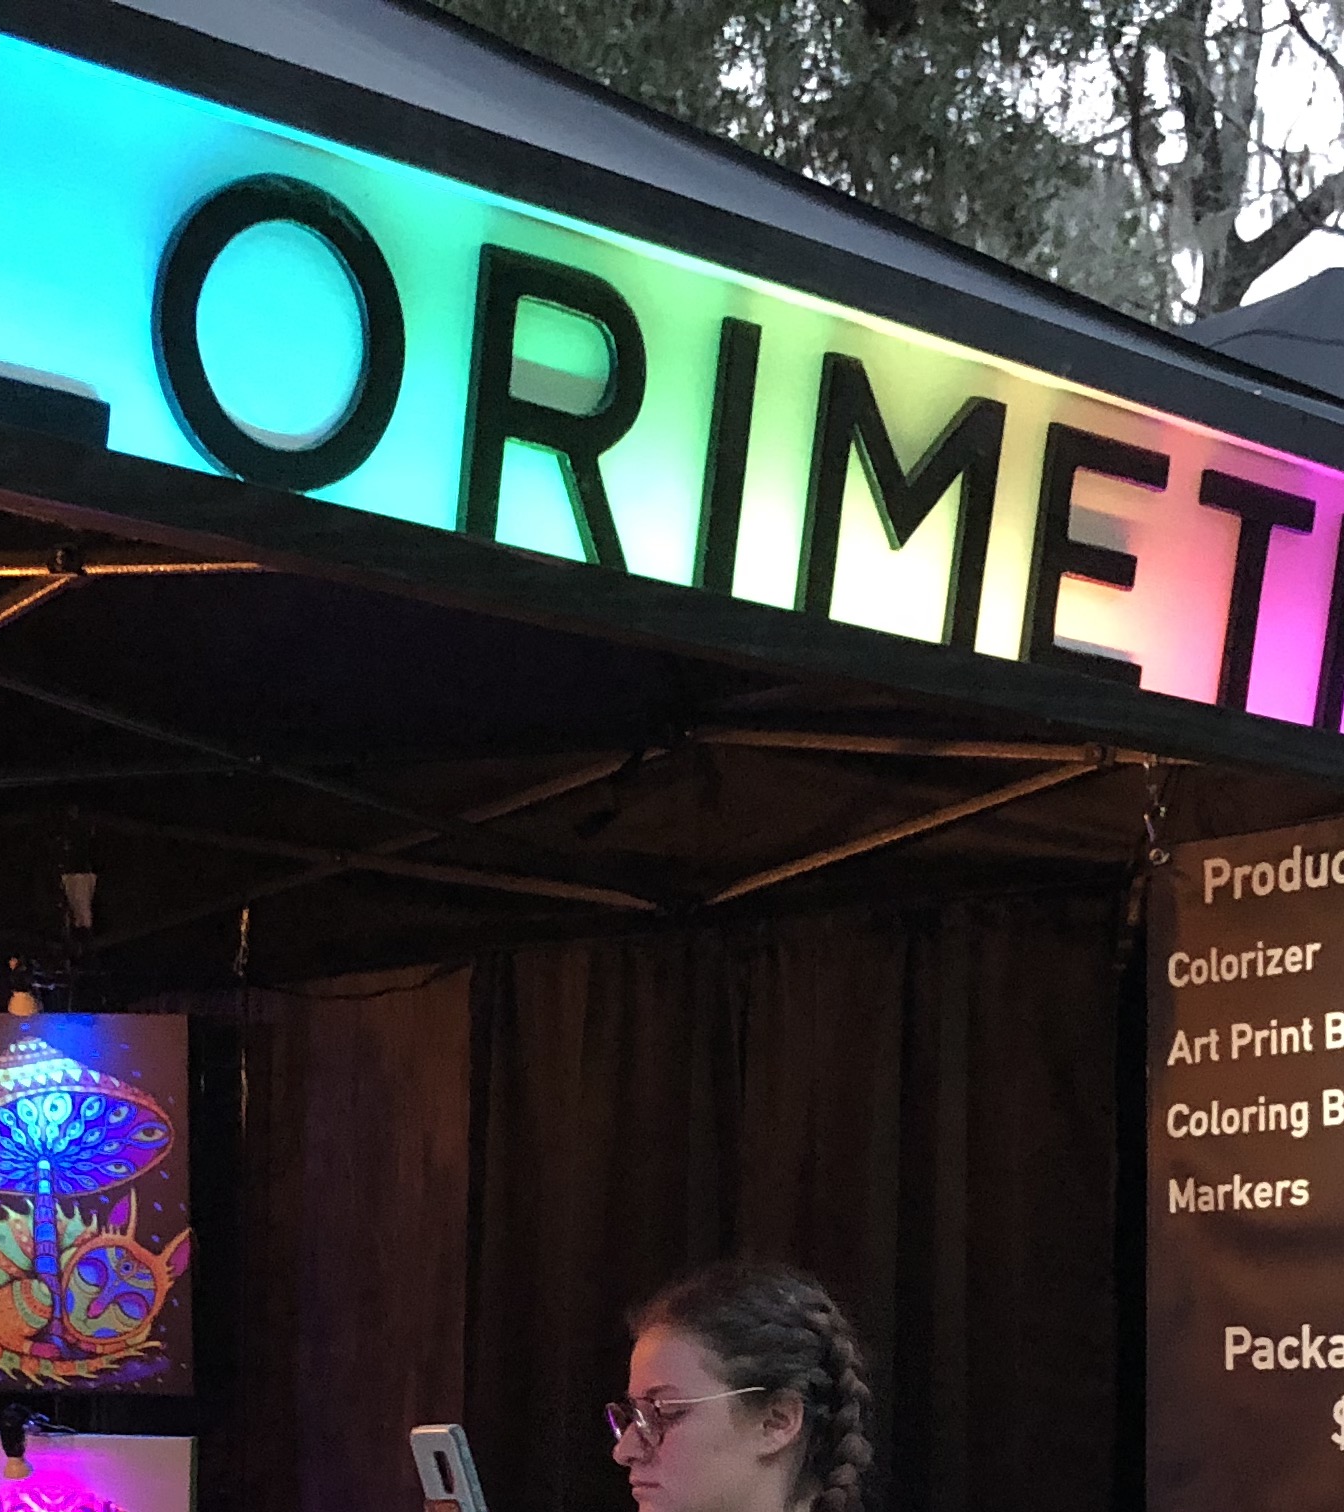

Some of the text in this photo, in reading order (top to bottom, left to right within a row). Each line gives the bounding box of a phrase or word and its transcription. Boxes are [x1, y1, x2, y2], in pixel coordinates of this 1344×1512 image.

[1168, 941, 1322, 988] Colorizer
[1167, 1028, 1220, 1066] Art
[1231, 1017, 1314, 1060] Print
[1166, 1095, 1310, 1139] Coloring
[1168, 1174, 1310, 1214] Markers
